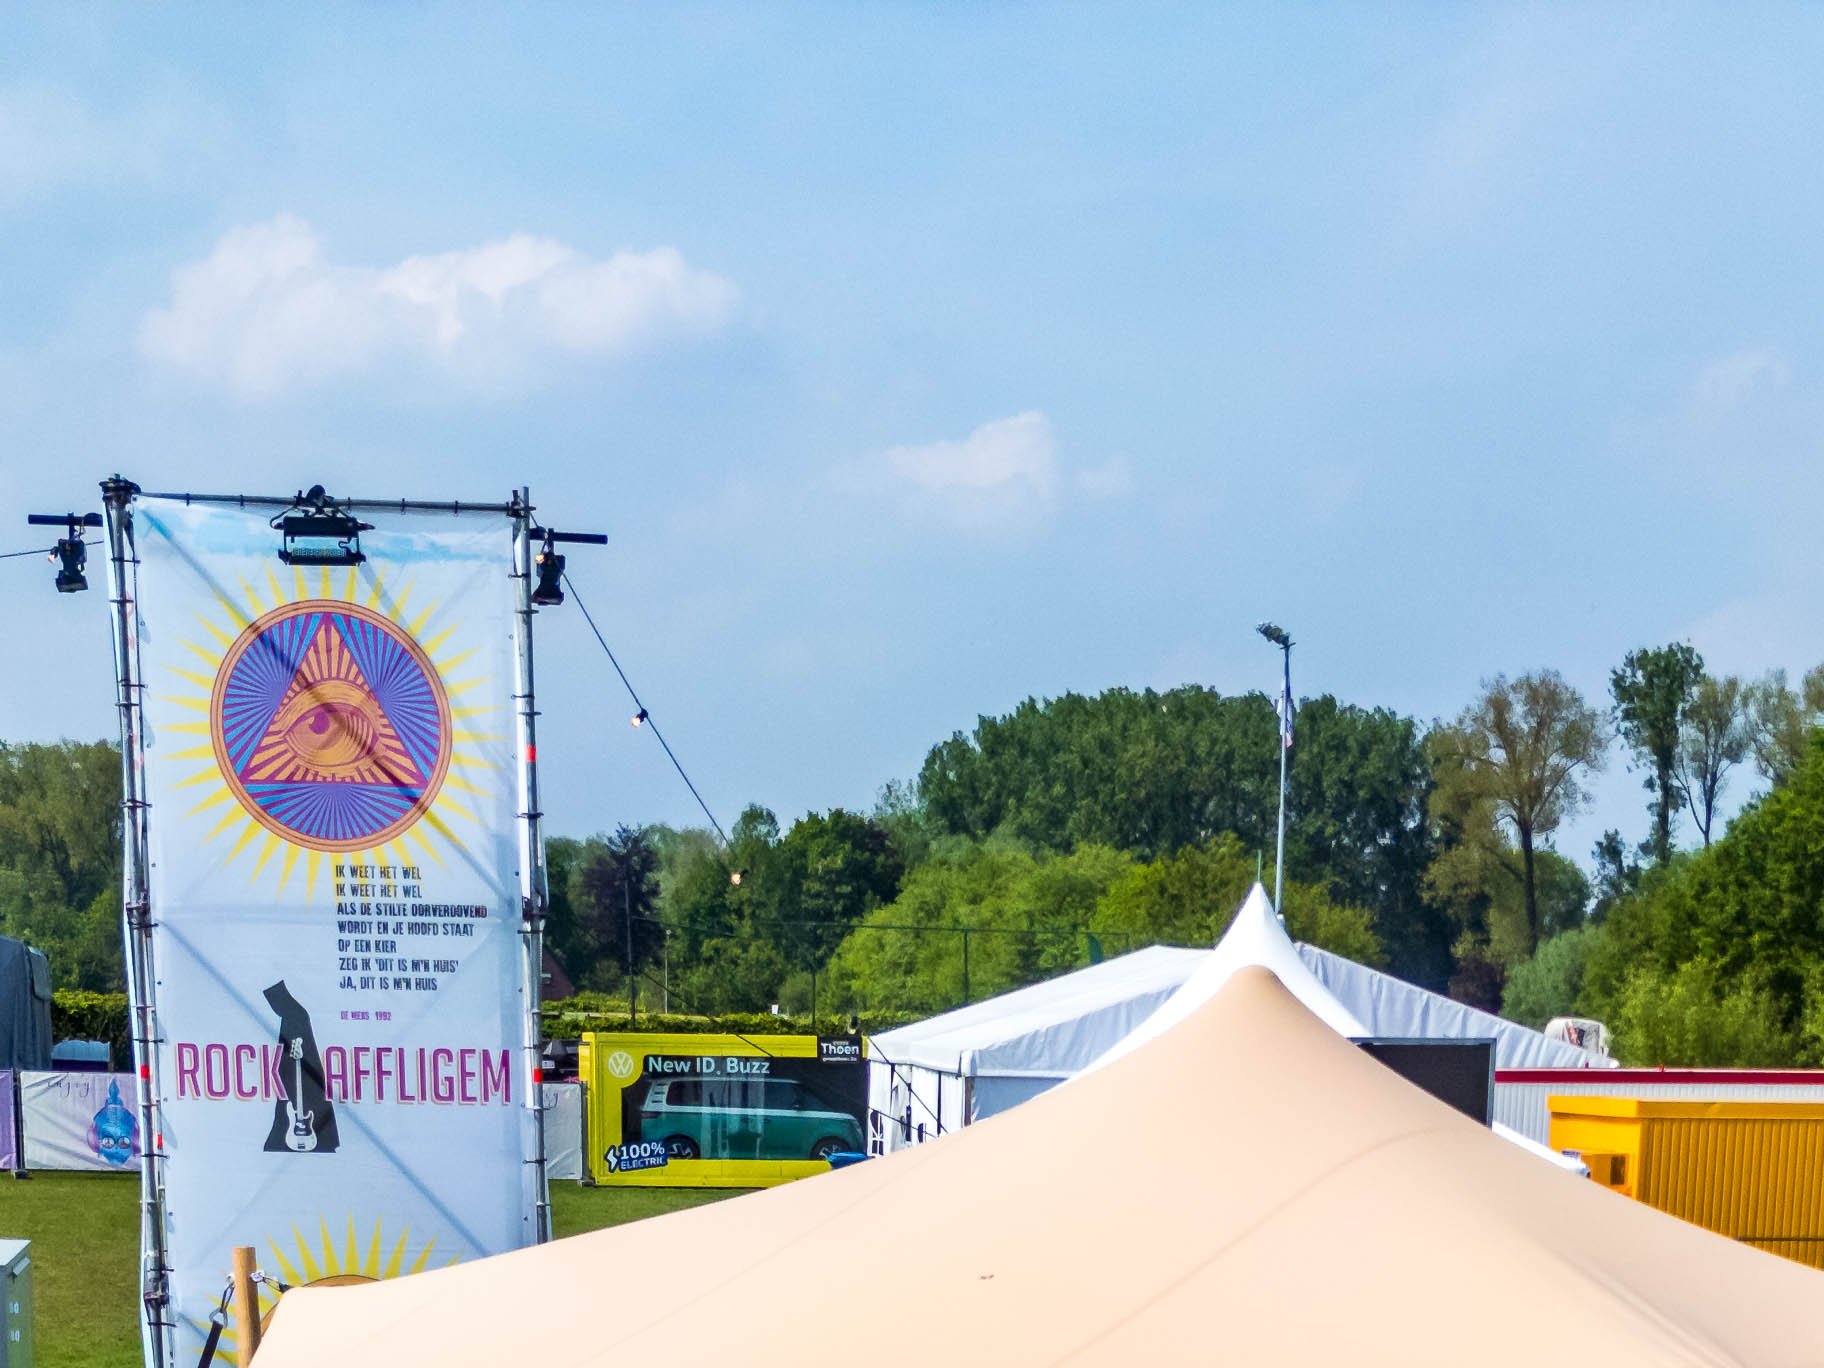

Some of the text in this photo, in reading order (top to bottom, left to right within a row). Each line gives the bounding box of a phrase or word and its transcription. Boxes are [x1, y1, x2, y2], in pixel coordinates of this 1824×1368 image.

[336, 865, 421, 880] IK WEET HET WEL
[336, 884, 422, 898] IK WEET HET WEL
[337, 903, 356, 915] ALS
[361, 903, 372, 915] DE
[376, 903, 408, 916] STILTE
[338, 921, 475, 936] WORDT EN JE HOOFD STAAT
[338, 939, 397, 953] OP EEN KIER
[339, 958, 358, 971] ZEG
[362, 958, 371, 971] IK
[398, 959, 407, 972] IS
[360, 977, 375, 989] DIT
[380, 977, 389, 990] IS
[415, 978, 437, 991] HUIS
[820, 1042, 860, 1055] Thoen
[648, 1057, 690, 1073] New
[726, 1058, 770, 1074] Buzz
[175, 1042, 512, 1105] ROCK AFFLIGEM
[620, 1142, 665, 1160] 100%
